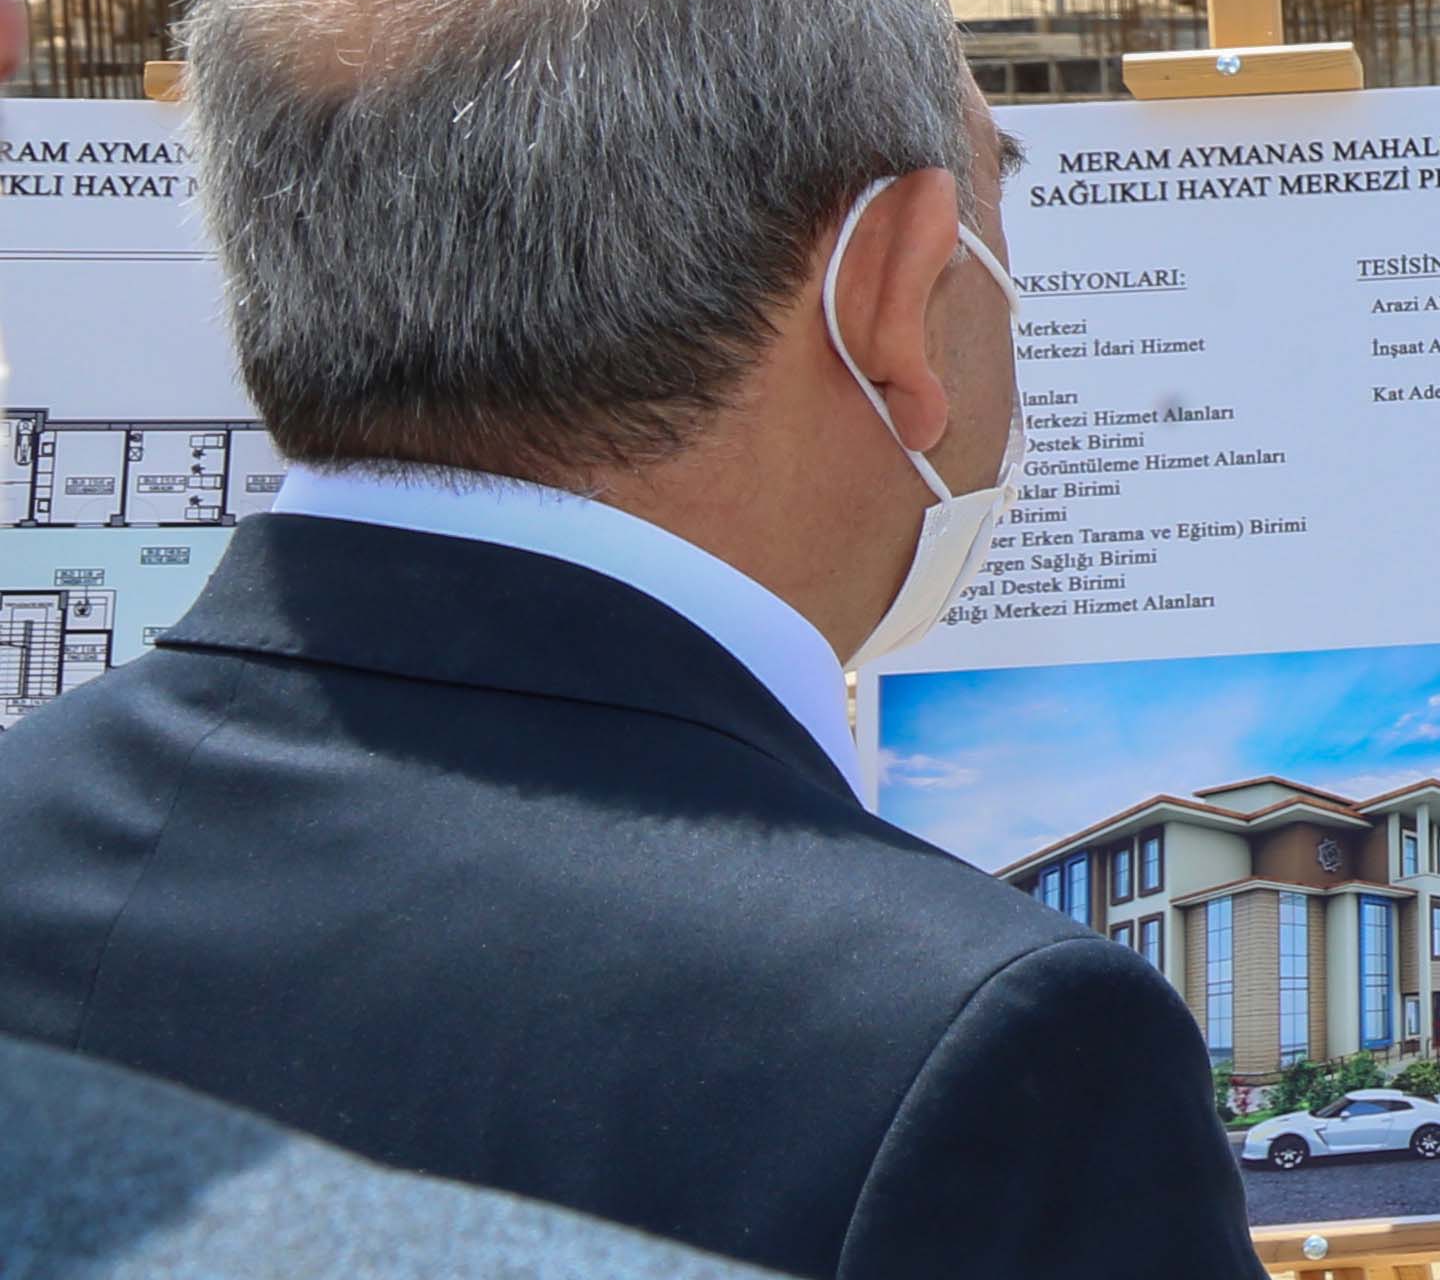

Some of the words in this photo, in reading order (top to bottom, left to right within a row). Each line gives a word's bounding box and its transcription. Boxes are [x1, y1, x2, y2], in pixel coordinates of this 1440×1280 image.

[1059, 148, 1171, 173] MERAM
[1177, 141, 1323, 169] AYMANAS
[72, 174, 178, 197] HAYAT
[1030, 179, 1169, 207] SAĞLIKLI
[1176, 175, 1272, 200] HAYAT
[1278, 165, 1410, 196] MERKEZİ
[1371, 294, 1419, 314] Arazi
[1017, 320, 1088, 337] Merkezi
[1016, 342, 1087, 360] Merkezi
[1094, 338, 1135, 357] İdari
[1140, 337, 1205, 355] Hizmet
[1372, 338, 1424, 359] İnşaat
[1372, 385, 1404, 402] Kat
[1094, 408, 1157, 427] Hizmet
[1163, 405, 1234, 423] Alanları
[1088, 431, 1144, 450] Birimi
[1024, 456, 1139, 476] Görüntüleme
[1144, 452, 1209, 472] Hizmet
[1214, 448, 1286, 467] Alanları
[1064, 480, 1121, 498] Birimi
[1010, 506, 1067, 524] Birimi
[1021, 530, 1074, 547] Erken
[1078, 527, 1145, 545] Tarama
[1150, 528, 1172, 540] ve
[1177, 519, 1245, 540] Eğitim)
[1248, 516, 1308, 535] Birimi
[1030, 552, 1094, 572] Sağlığı
[1100, 548, 1158, 566] Birimi
[1001, 577, 1063, 596] Destek
[1068, 573, 1126, 592] Birimi
[993, 600, 1068, 620] Merkezi
[1073, 595, 1138, 615] Hizmet
[1143, 592, 1216, 612] Alanları
